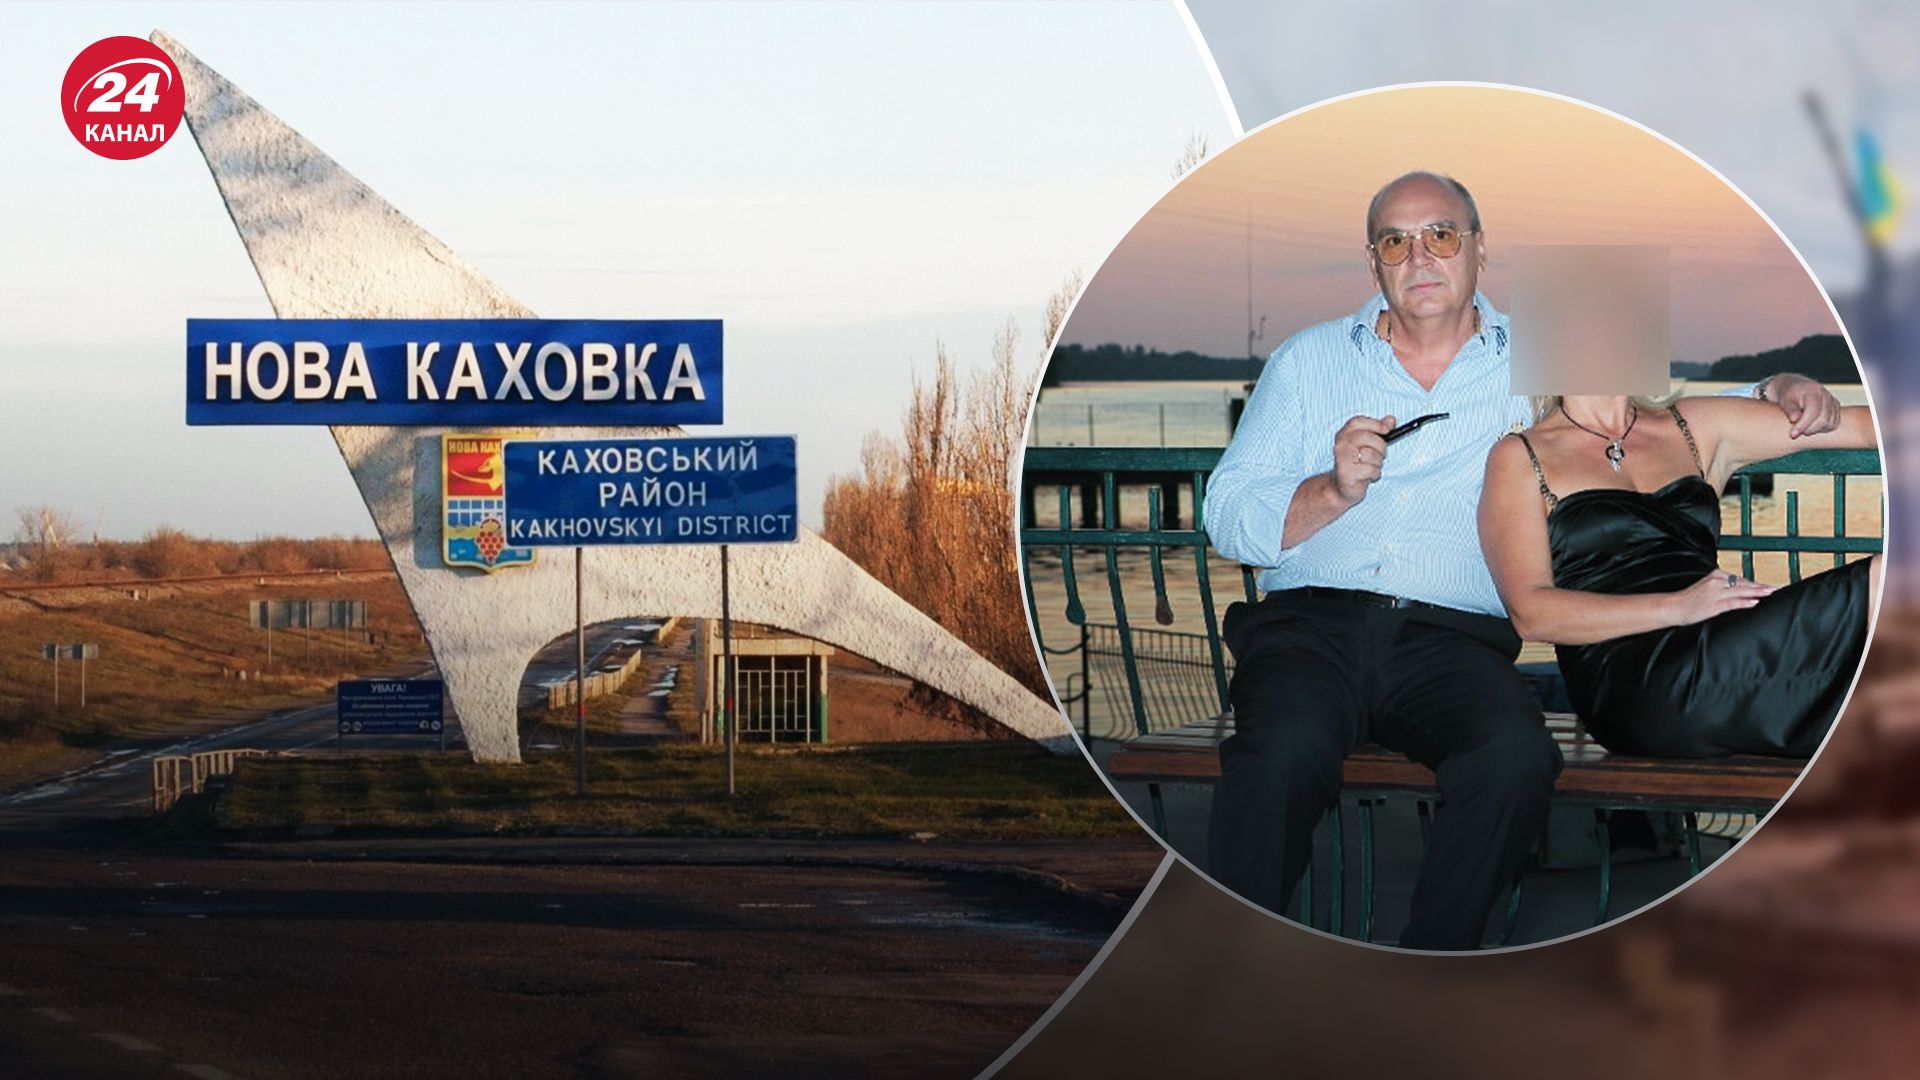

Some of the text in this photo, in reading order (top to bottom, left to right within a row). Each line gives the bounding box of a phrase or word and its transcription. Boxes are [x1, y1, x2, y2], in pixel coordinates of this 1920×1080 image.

[205, 342, 706, 401] НОВА КАХОВКА
[449, 441, 502, 453] НОВА КАХ
[538, 440, 758, 475] КАХОВСЬКИЙ
[599, 477, 707, 507] РАЙОН
[510, 514, 792, 538] KAKHOVSKYI DISTRICT
[371, 683, 407, 693] УВАГА!
